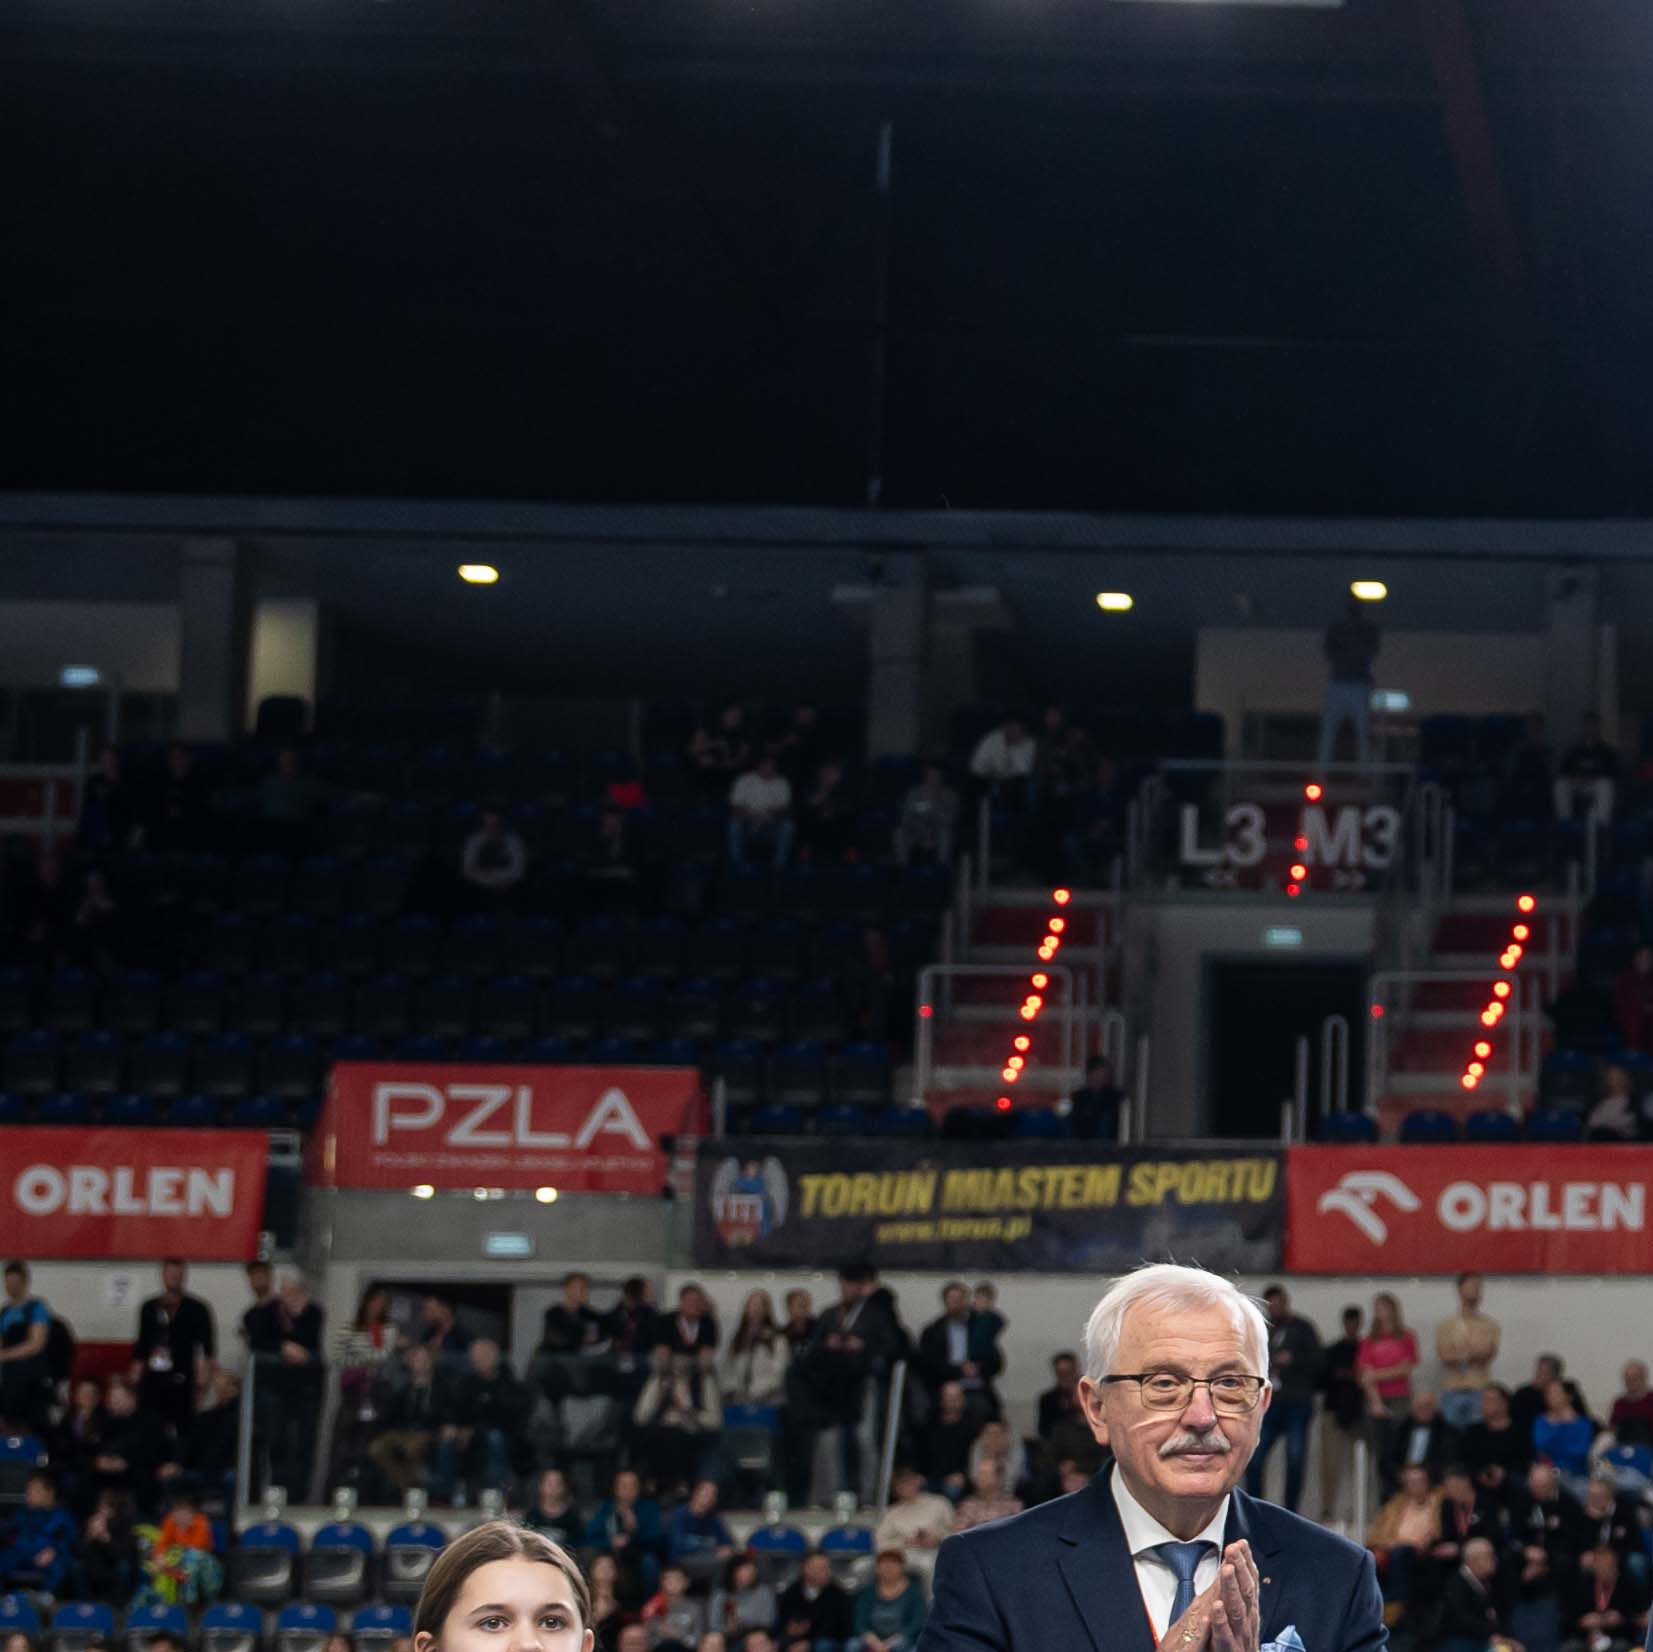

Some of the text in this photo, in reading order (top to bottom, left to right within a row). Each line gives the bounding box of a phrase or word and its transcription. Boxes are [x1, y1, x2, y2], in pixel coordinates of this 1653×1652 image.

[1180, 804, 1399, 869] L3 M3
[372, 1077, 652, 1149] PZLA
[15, 1164, 235, 1216] ORLEN
[941, 1164, 1122, 1211] MIASTEM
[1126, 1158, 1278, 1202] SPORTU
[1438, 1181, 1646, 1231] ORLEN
